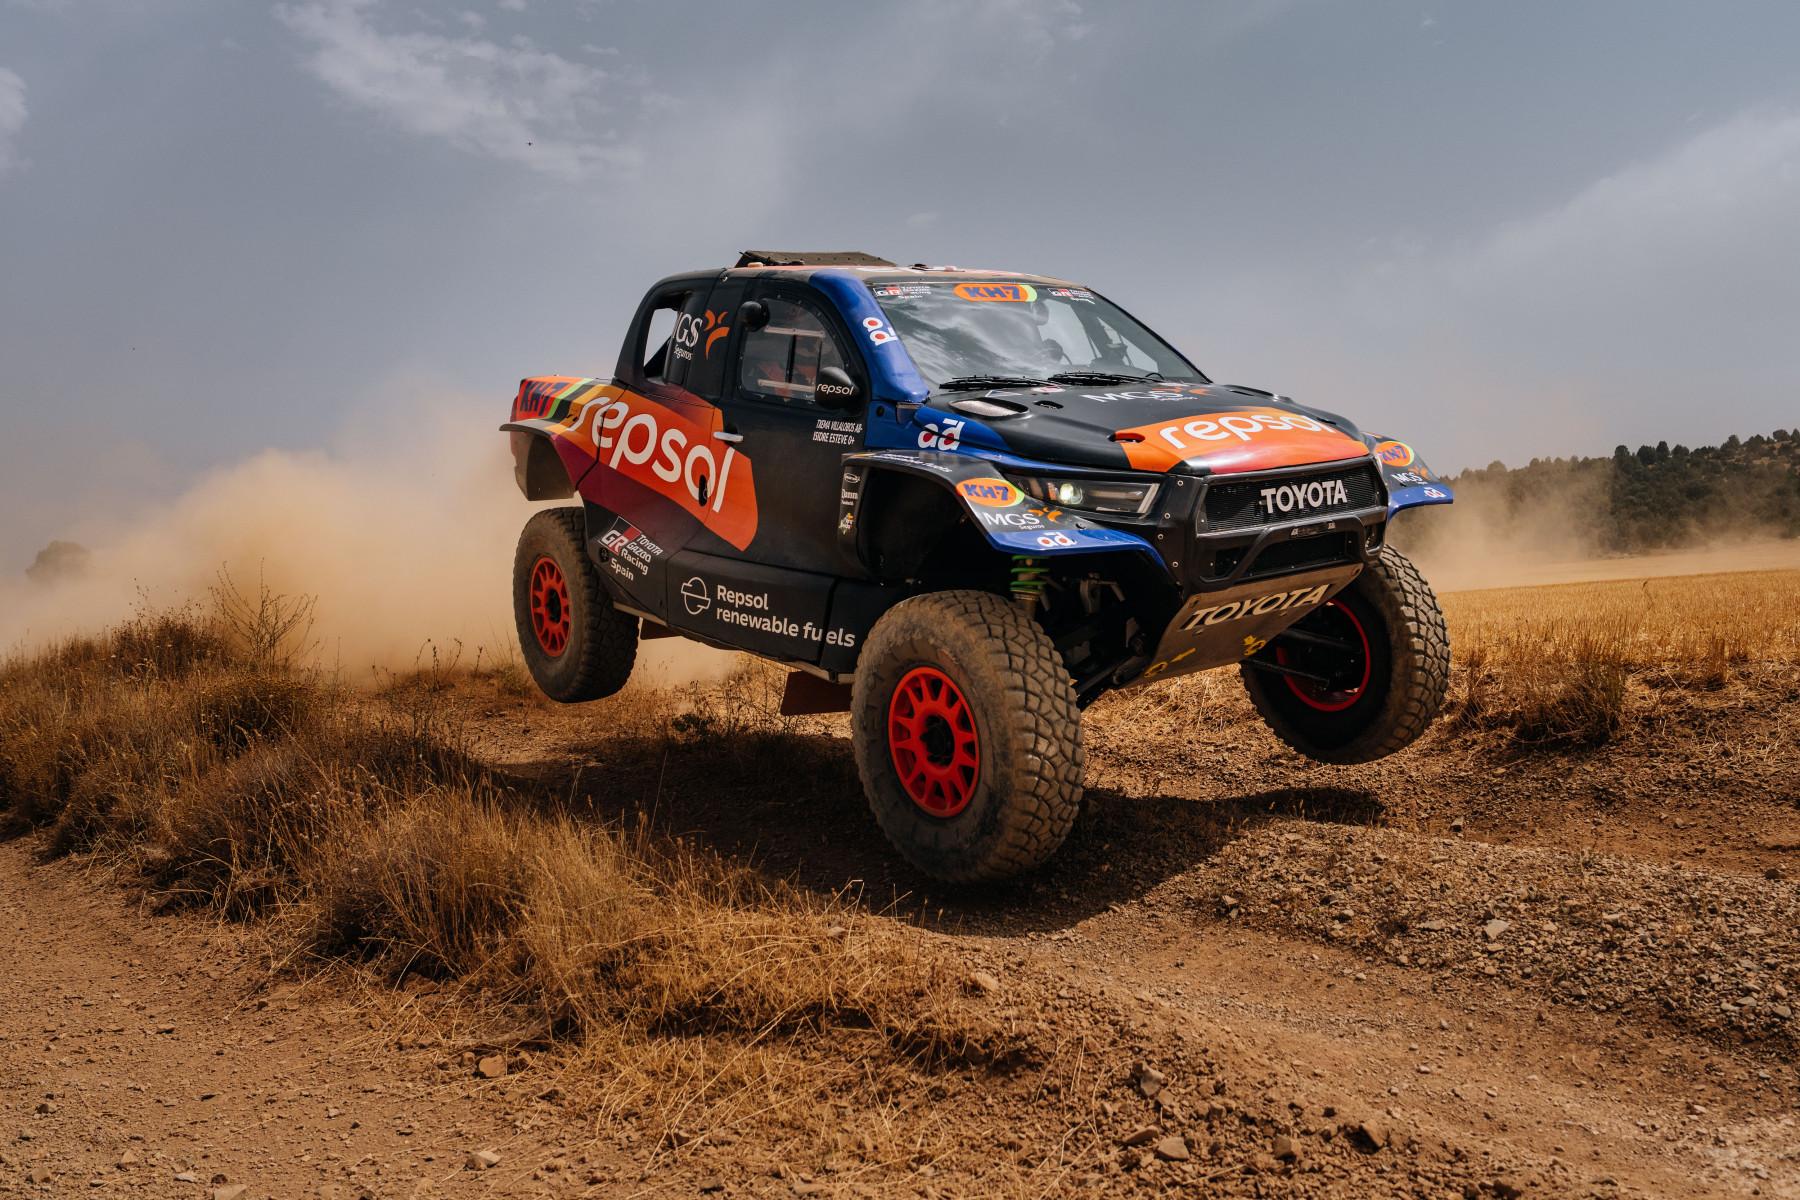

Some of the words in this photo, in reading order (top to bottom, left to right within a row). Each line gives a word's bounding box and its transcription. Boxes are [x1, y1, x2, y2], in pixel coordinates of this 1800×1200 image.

[816, 383, 855, 396] repsol
[1158, 413, 1337, 450] repsol
[566, 396, 736, 513] repsol
[1261, 479, 1348, 514] TOYOTA
[983, 512, 1041, 526] MGS
[601, 529, 630, 555] GR
[625, 541, 652, 564] GAZOO
[636, 534, 664, 556] TOYOTA
[610, 558, 635, 581] Spain
[620, 548, 650, 576] Racing
[716, 584, 769, 611] Repsol
[1181, 583, 1331, 632] TOYOTA
[716, 607, 800, 637] renewable
[802, 621, 856, 648] fuels
